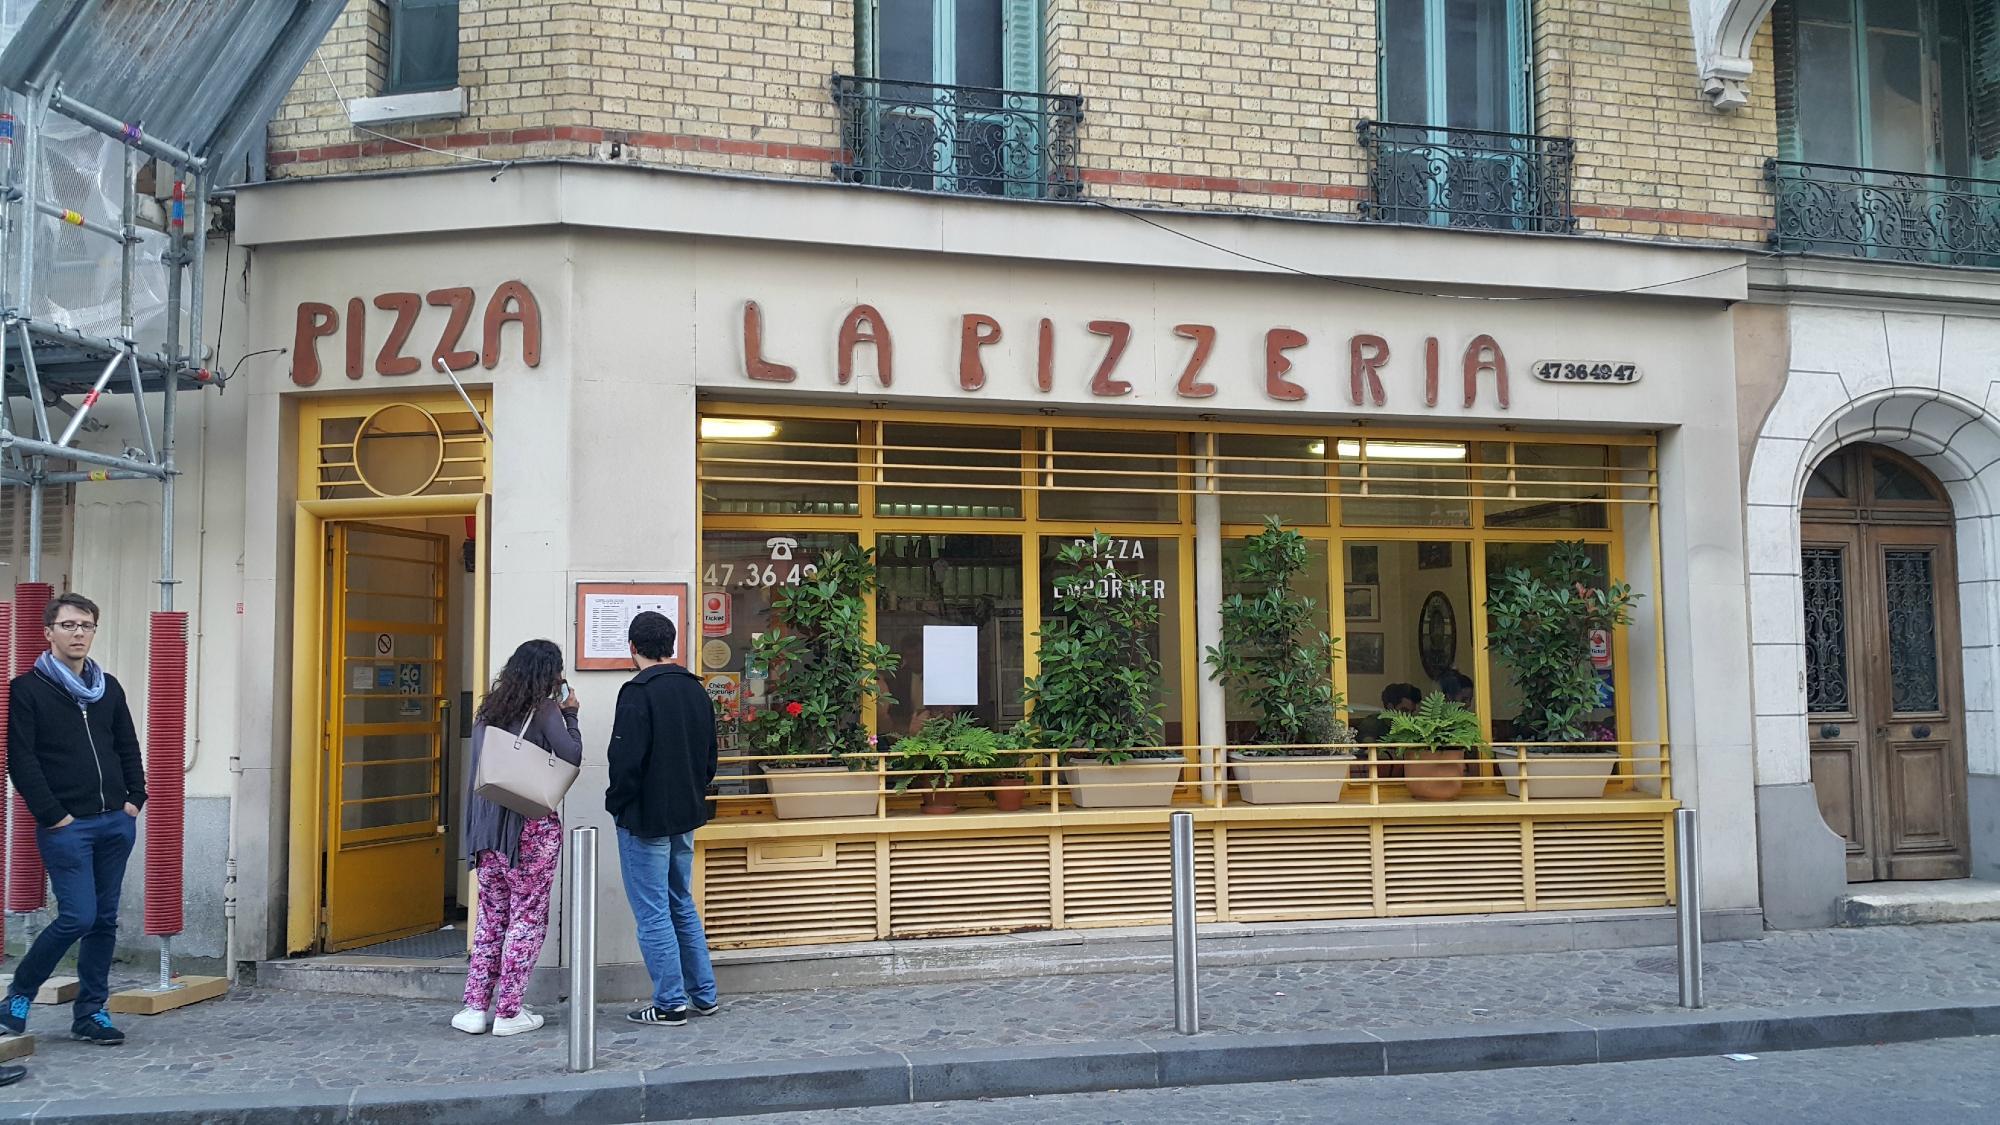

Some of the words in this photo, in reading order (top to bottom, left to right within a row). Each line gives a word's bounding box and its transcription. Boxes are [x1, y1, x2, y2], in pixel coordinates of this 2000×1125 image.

[292, 280, 541, 387] PIZZA
[743, 300, 893, 388] LA
[959, 314, 1509, 409] PIZZERIA
